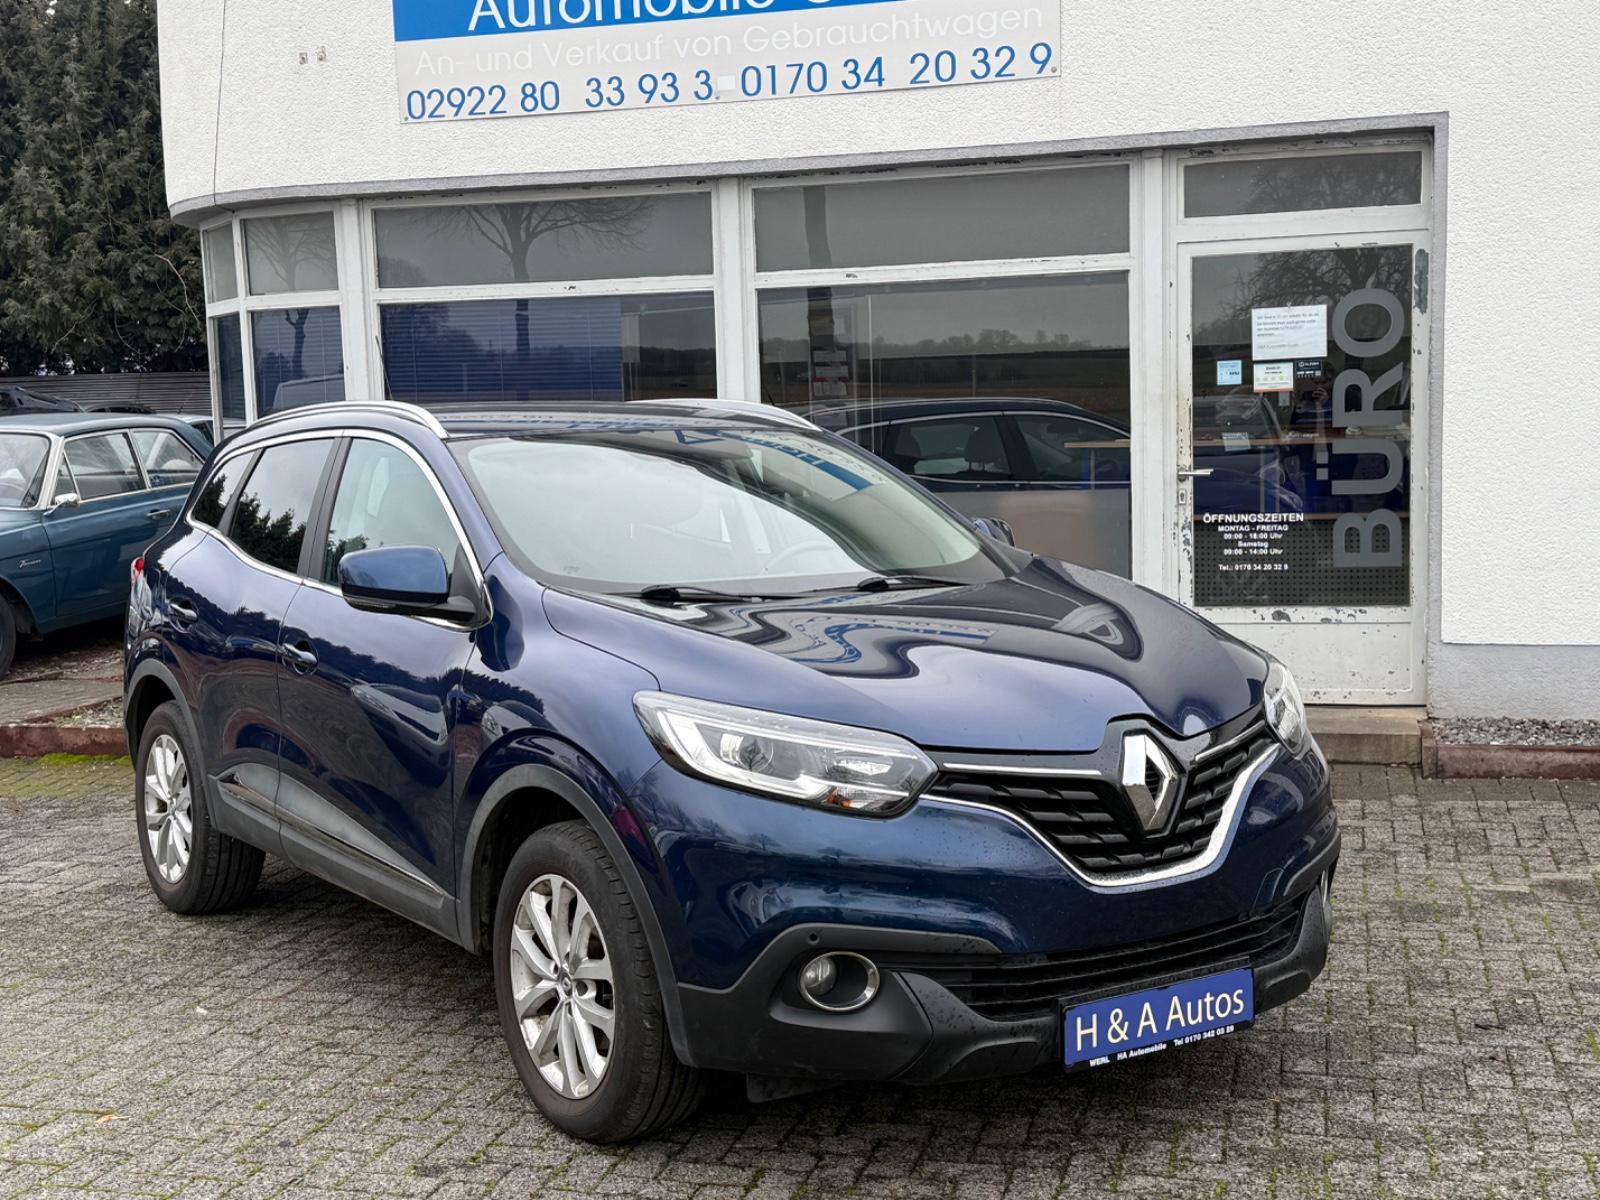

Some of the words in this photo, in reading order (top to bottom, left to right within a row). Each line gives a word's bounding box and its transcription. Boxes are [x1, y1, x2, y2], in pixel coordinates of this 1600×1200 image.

[415, 51, 465, 76] An-
[475, 46, 532, 72] und
[543, 33, 663, 68] Verkauf
[671, 33, 732, 58] von
[743, 7, 1042, 51] Gebrauchtwagen
[406, 85, 507, 120] 02922
[520, 81, 560, 112] 80
[585, 76, 625, 108] 33
[638, 72, 680, 104] 93
[693, 69, 714, 100] 3
[741, 61, 828, 97] 0170
[841, 56, 885, 90] 34
[909, 50, 957, 85] 20
[970, 46, 1016, 80] 32
[1030, 42, 1052, 75] 9
[1316, 287, 1405, 567] BÜRO
[1202, 512, 1304, 523] ÖFFNUNGSZEITEN
[1076, 1013, 1098, 1051] H
[1107, 1008, 1129, 1044] &
[1137, 1002, 1158, 1038] A
[1165, 989, 1245, 1031] Autos
[1128, 1043, 1167, 1058] Automobile
